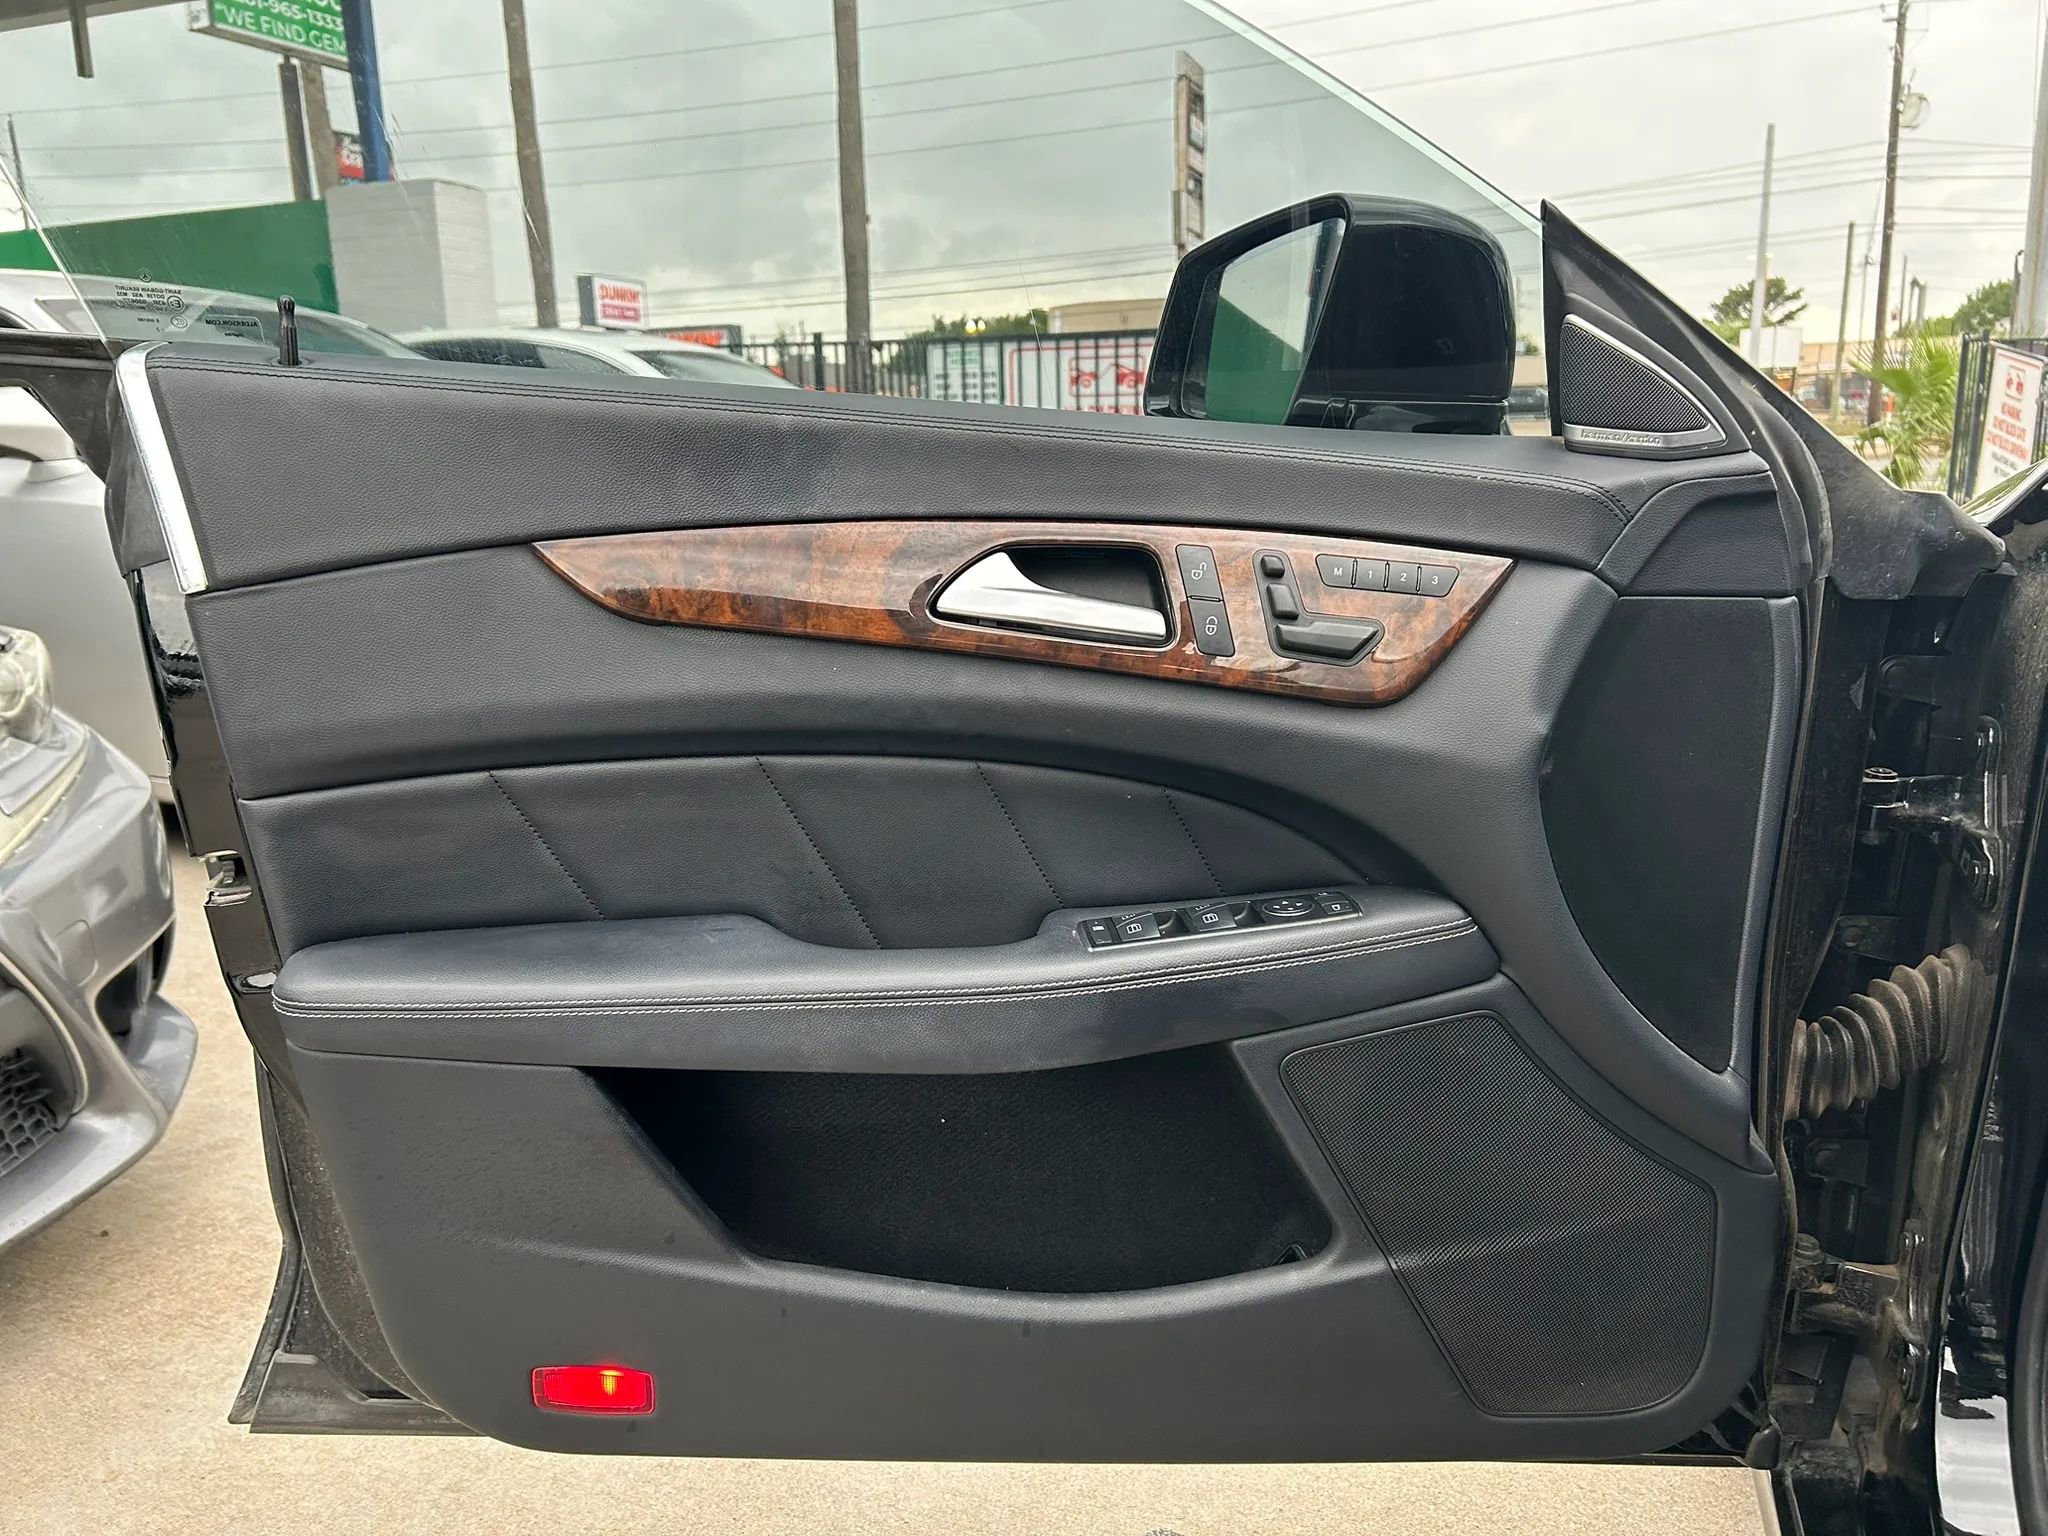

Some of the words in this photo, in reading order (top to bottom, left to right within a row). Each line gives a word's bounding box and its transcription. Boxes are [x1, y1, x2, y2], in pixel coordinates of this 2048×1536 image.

[260, 15, 306, 43] FIND
[1333, 567, 1343, 577] M
[1367, 571, 1373, 579] 1
[1399, 572, 1408, 582] 2
[1431, 575, 1439, 585] 3
